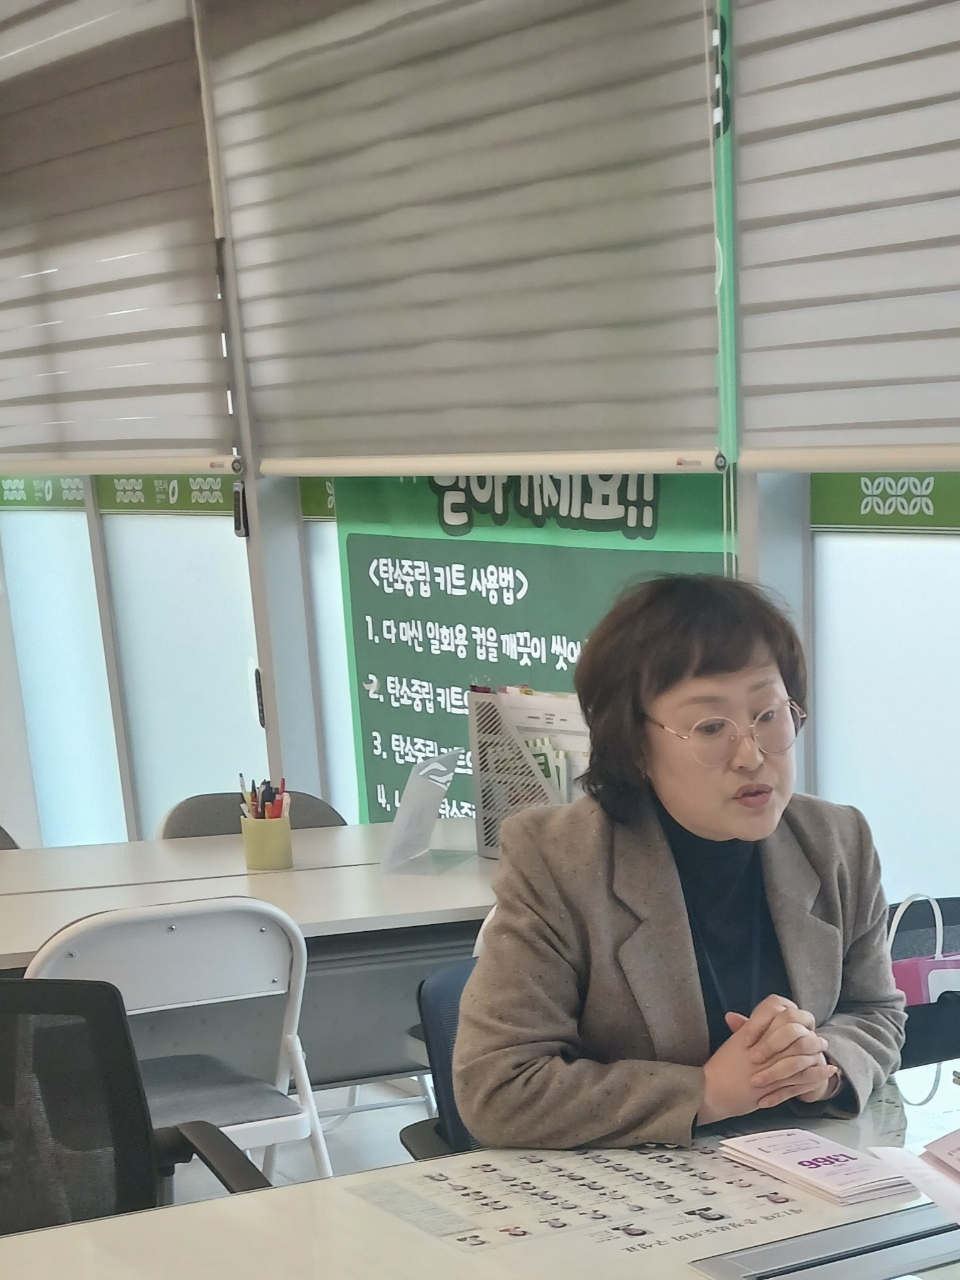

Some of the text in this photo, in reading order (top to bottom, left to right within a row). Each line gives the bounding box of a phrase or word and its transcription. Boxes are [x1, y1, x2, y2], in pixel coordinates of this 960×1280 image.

[433, 564, 467, 596] 키트
[365, 615, 380, 643] 1.
[382, 619, 397, 644] 다
[399, 619, 423, 652] 마신
[426, 621, 469, 659] 일회용
[471, 626, 499, 663] 컵을
[500, 631, 547, 667] 깨끗이
[362, 673, 471, 716] 2. 탄소중립 키트
[371, 731, 388, 759] 3.
[376, 784, 391, 812] 4.
[798, 1152, 858, 1169] 1366
